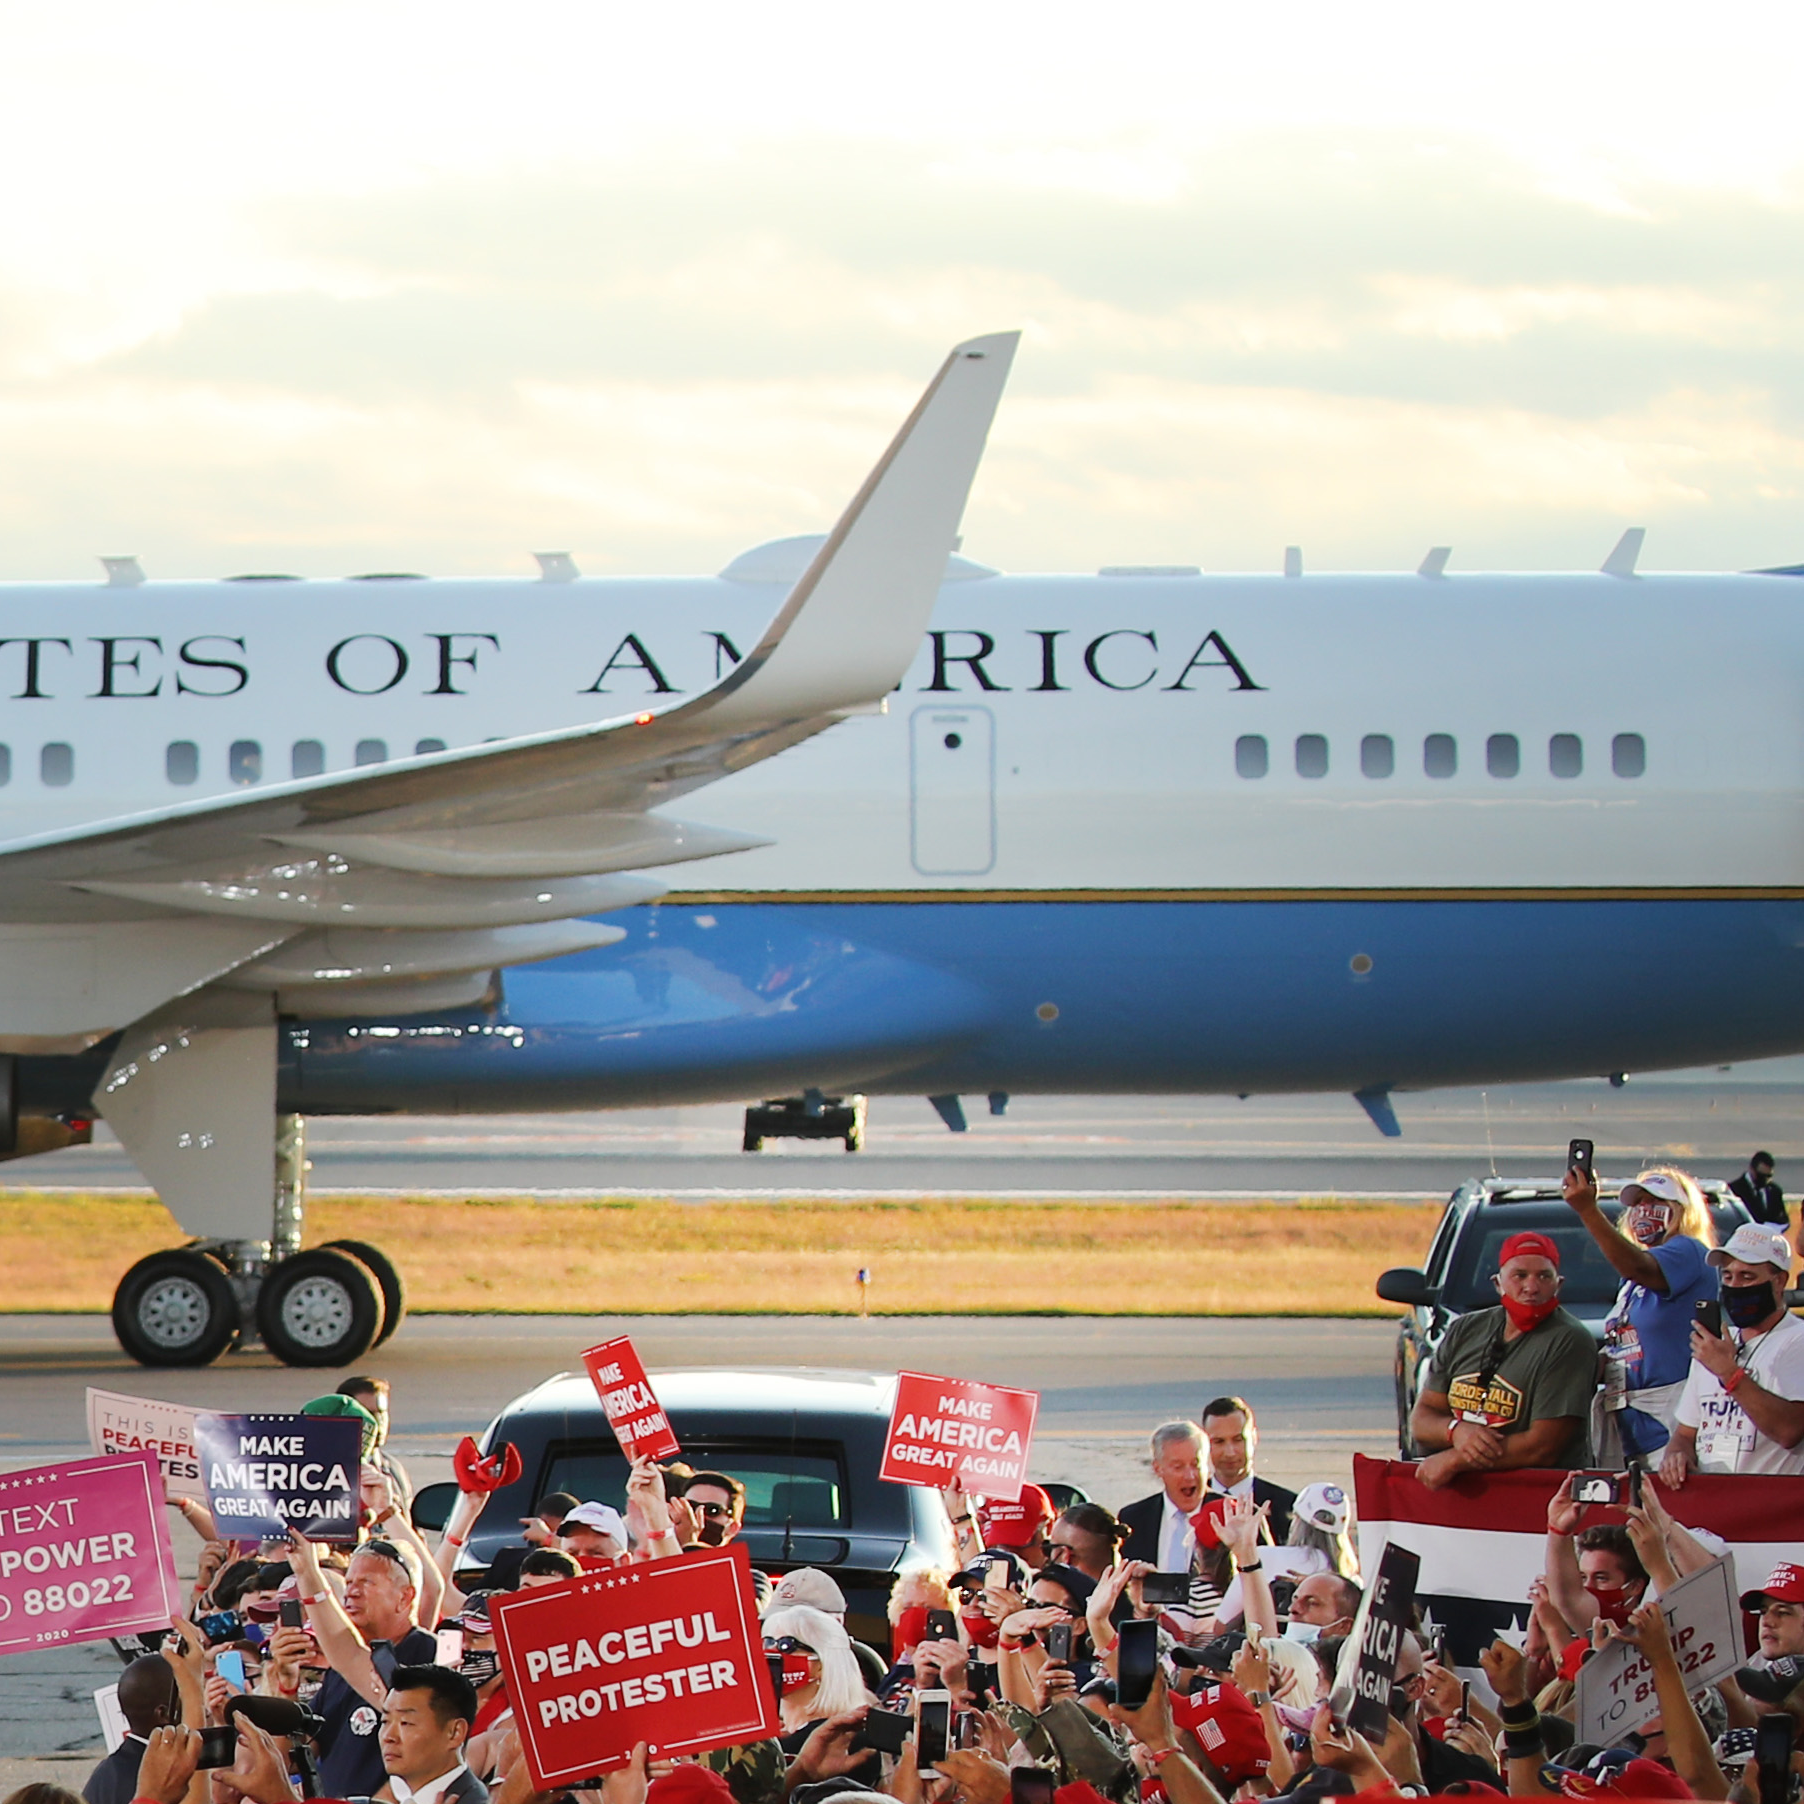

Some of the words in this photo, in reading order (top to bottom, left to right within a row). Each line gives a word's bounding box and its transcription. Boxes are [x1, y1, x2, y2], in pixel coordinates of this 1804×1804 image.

[326, 632, 501, 696] OF
[597, 1362, 624, 1387] MAKE
[938, 1396, 994, 1421] MAKE
[104, 1412, 155, 1435] THIS
[170, 1425, 189, 1440] IS
[895, 1413, 1022, 1456] AMERICA
[239, 1436, 305, 1458] MAKE
[892, 1444, 959, 1471] GREAT
[959, 1453, 1021, 1480] AGAIN
[210, 1463, 352, 1494] AMERICA
[214, 1496, 268, 1518] GREAT
[274, 1497, 352, 1521] AGAIN
[22, 1575, 135, 1617] 88022
[36, 1628, 70, 1644] 2020
[524, 1611, 731, 1684] PEACEFUL
[539, 1658, 739, 1729] PROTESTER
[1597, 1698, 1629, 1732] TO
